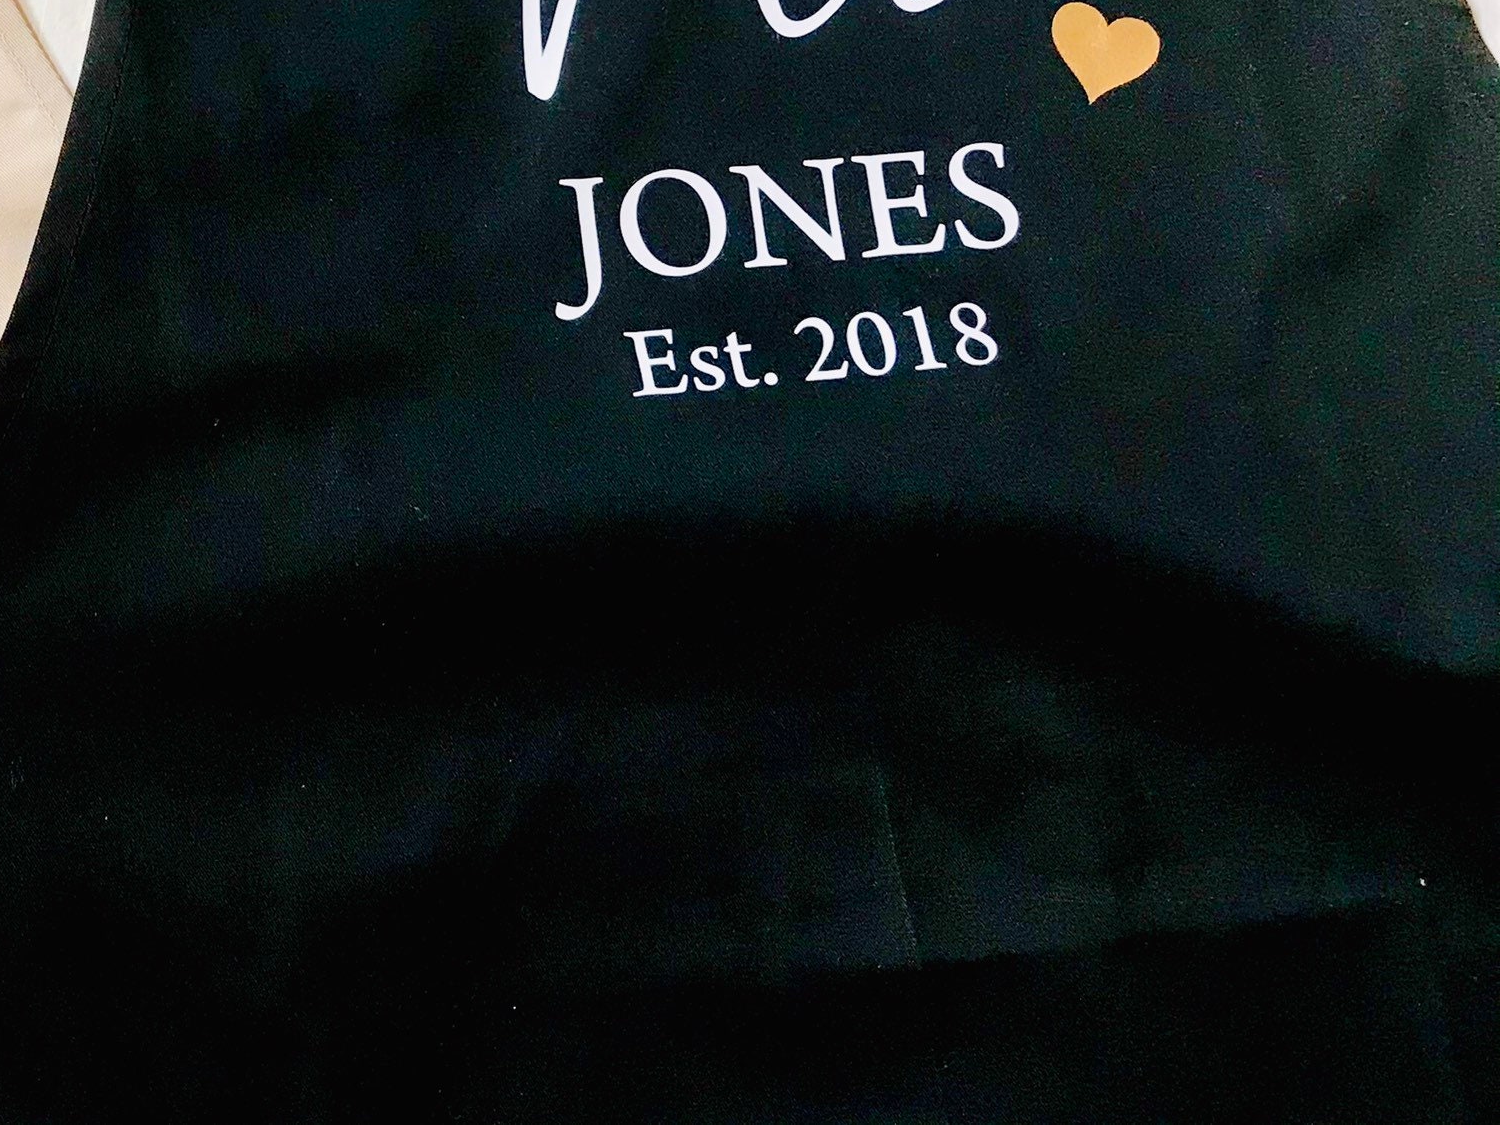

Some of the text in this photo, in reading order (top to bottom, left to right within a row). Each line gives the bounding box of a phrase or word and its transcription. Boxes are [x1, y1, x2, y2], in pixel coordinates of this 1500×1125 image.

[553, 142, 1021, 321] JONES
[622, 302, 999, 398] Est. 2018
